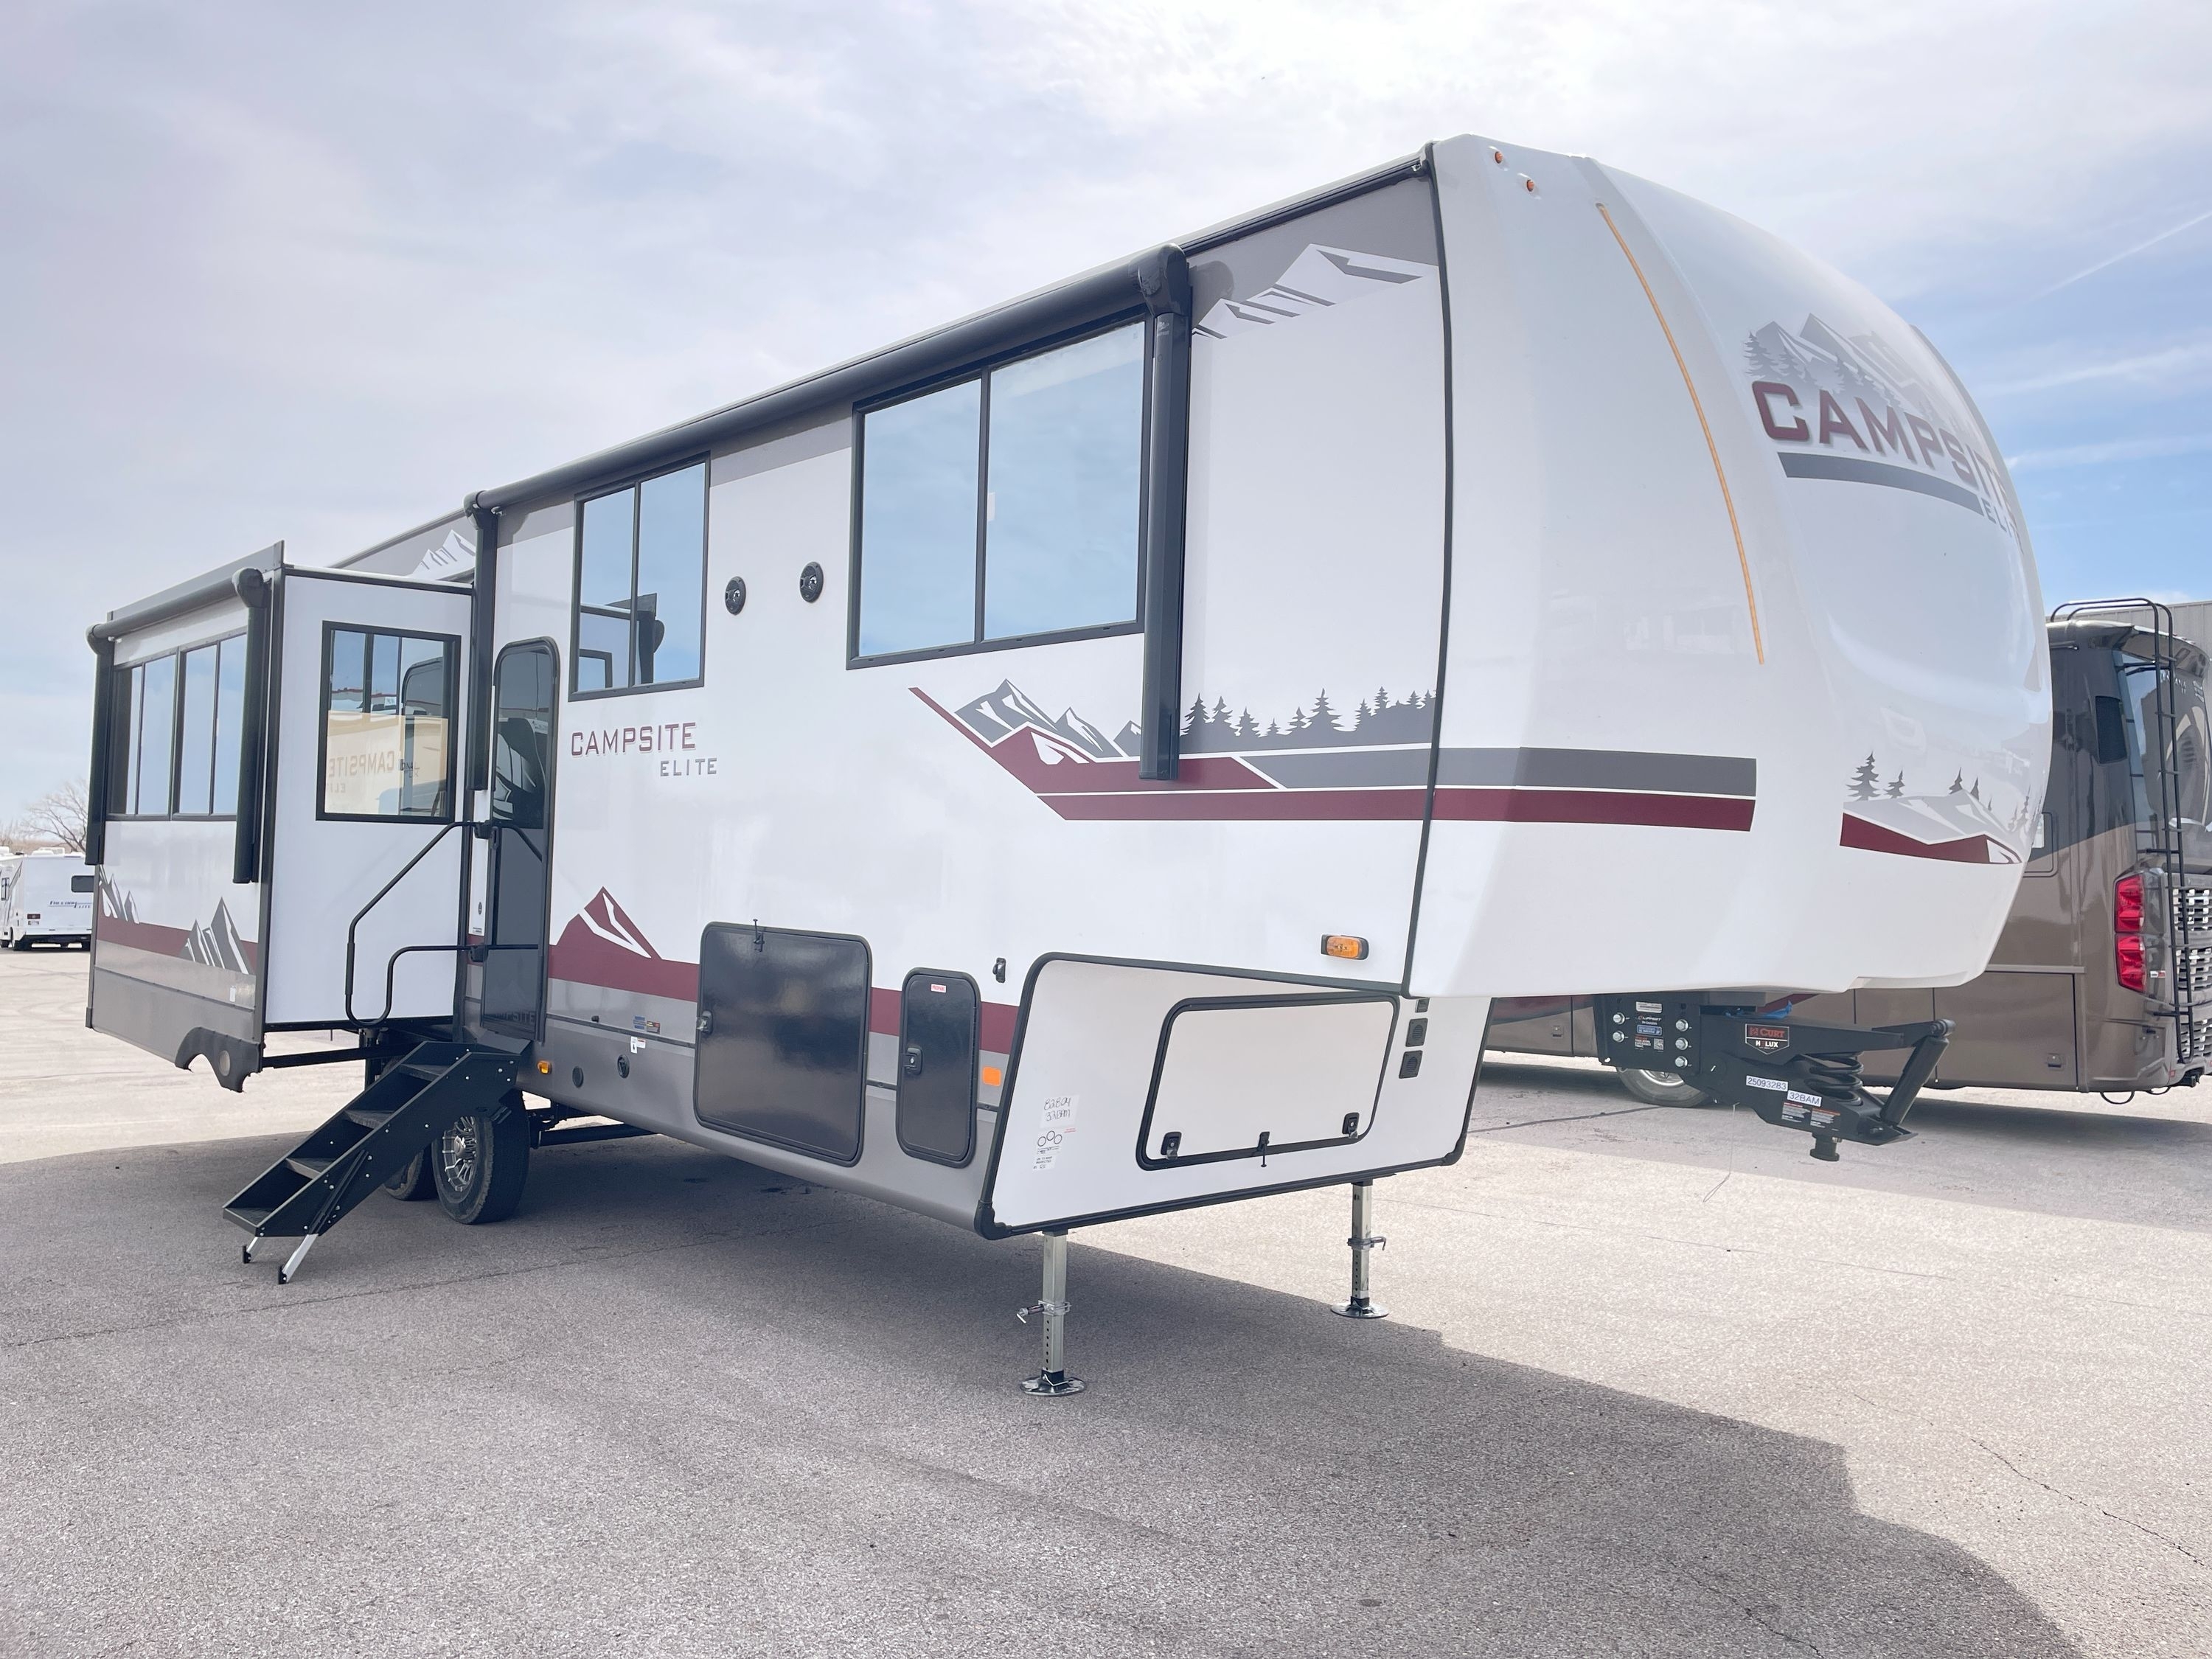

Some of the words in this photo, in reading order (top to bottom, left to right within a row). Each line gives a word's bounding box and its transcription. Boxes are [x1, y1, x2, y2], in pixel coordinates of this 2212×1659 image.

[571, 722, 696, 757] CAMPSITE
[660, 757, 717, 777] ELITE
[1747, 1077, 1787, 1090] 25093283
[1789, 1092, 1820, 1105] 32BAM
